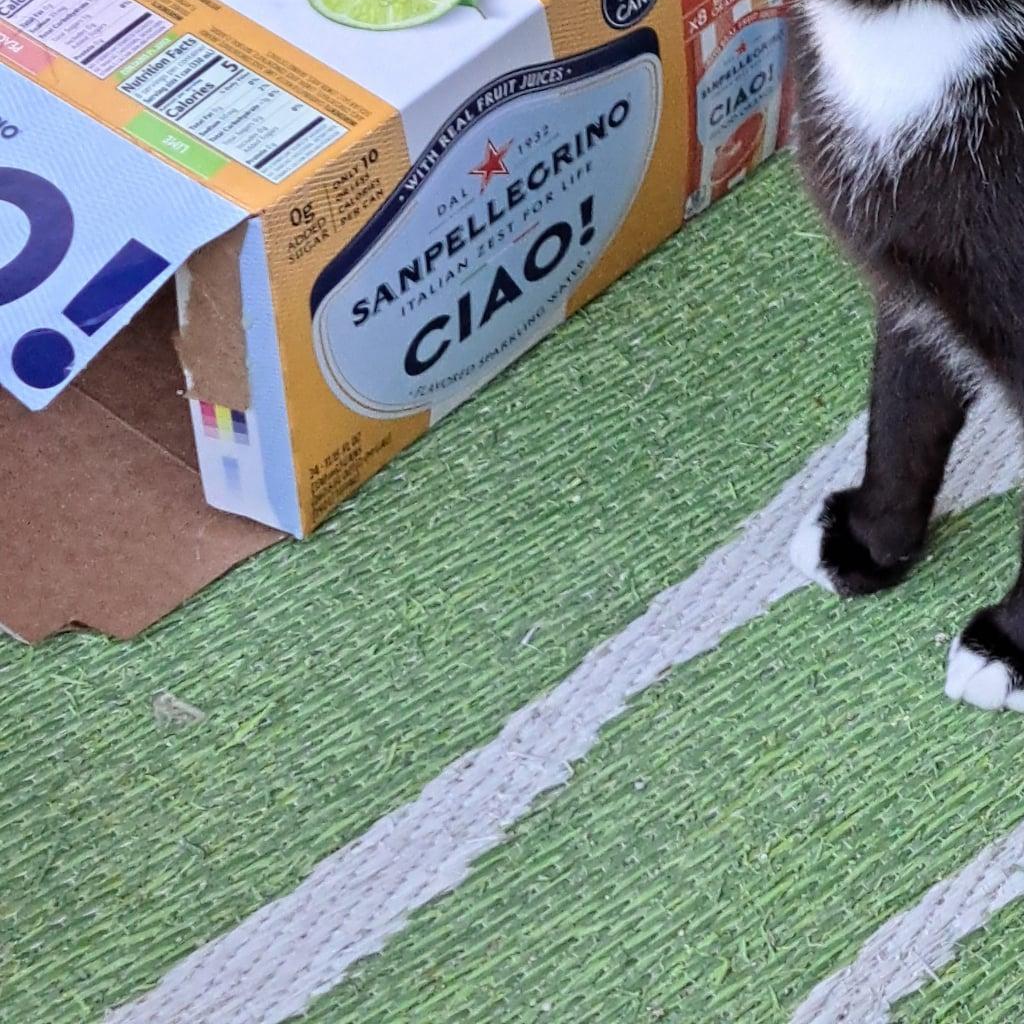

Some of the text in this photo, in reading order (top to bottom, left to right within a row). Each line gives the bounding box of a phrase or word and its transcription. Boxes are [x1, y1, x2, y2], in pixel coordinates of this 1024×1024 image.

[119, 55, 171, 93] Nutrition
[163, 35, 197, 59] Facts
[142, 85, 168, 104] Serving
[178, 67, 192, 76] can
[162, 80, 216, 119] Calories
[219, 59, 240, 72] 5
[708, 63, 775, 127] CIAO!
[222, 103, 261, 132] Carbohydrate
[404, 68, 566, 192] WITH REAL FRUIT JUICES
[161, 135, 190, 153] LIME
[517, 124, 552, 155] 1932
[332, 148, 378, 190] ONLY 10
[289, 199, 316, 227] 0g
[338, 177, 381, 214] CALORIES
[340, 188, 384, 226] PER CAN
[352, 99, 631, 327] SANPELLEGRINO
[436, 188, 469, 218] DAL
[288, 216, 327, 252] ADDED
[288, 228, 330, 265] SUGAR
[400, 160, 594, 317] ITALIAN ZEST FOR LIFE
[404, 194, 597, 377] CIAO!
[476, 308, 545, 370] SPARKLING
[546, 259, 587, 304] WATER
